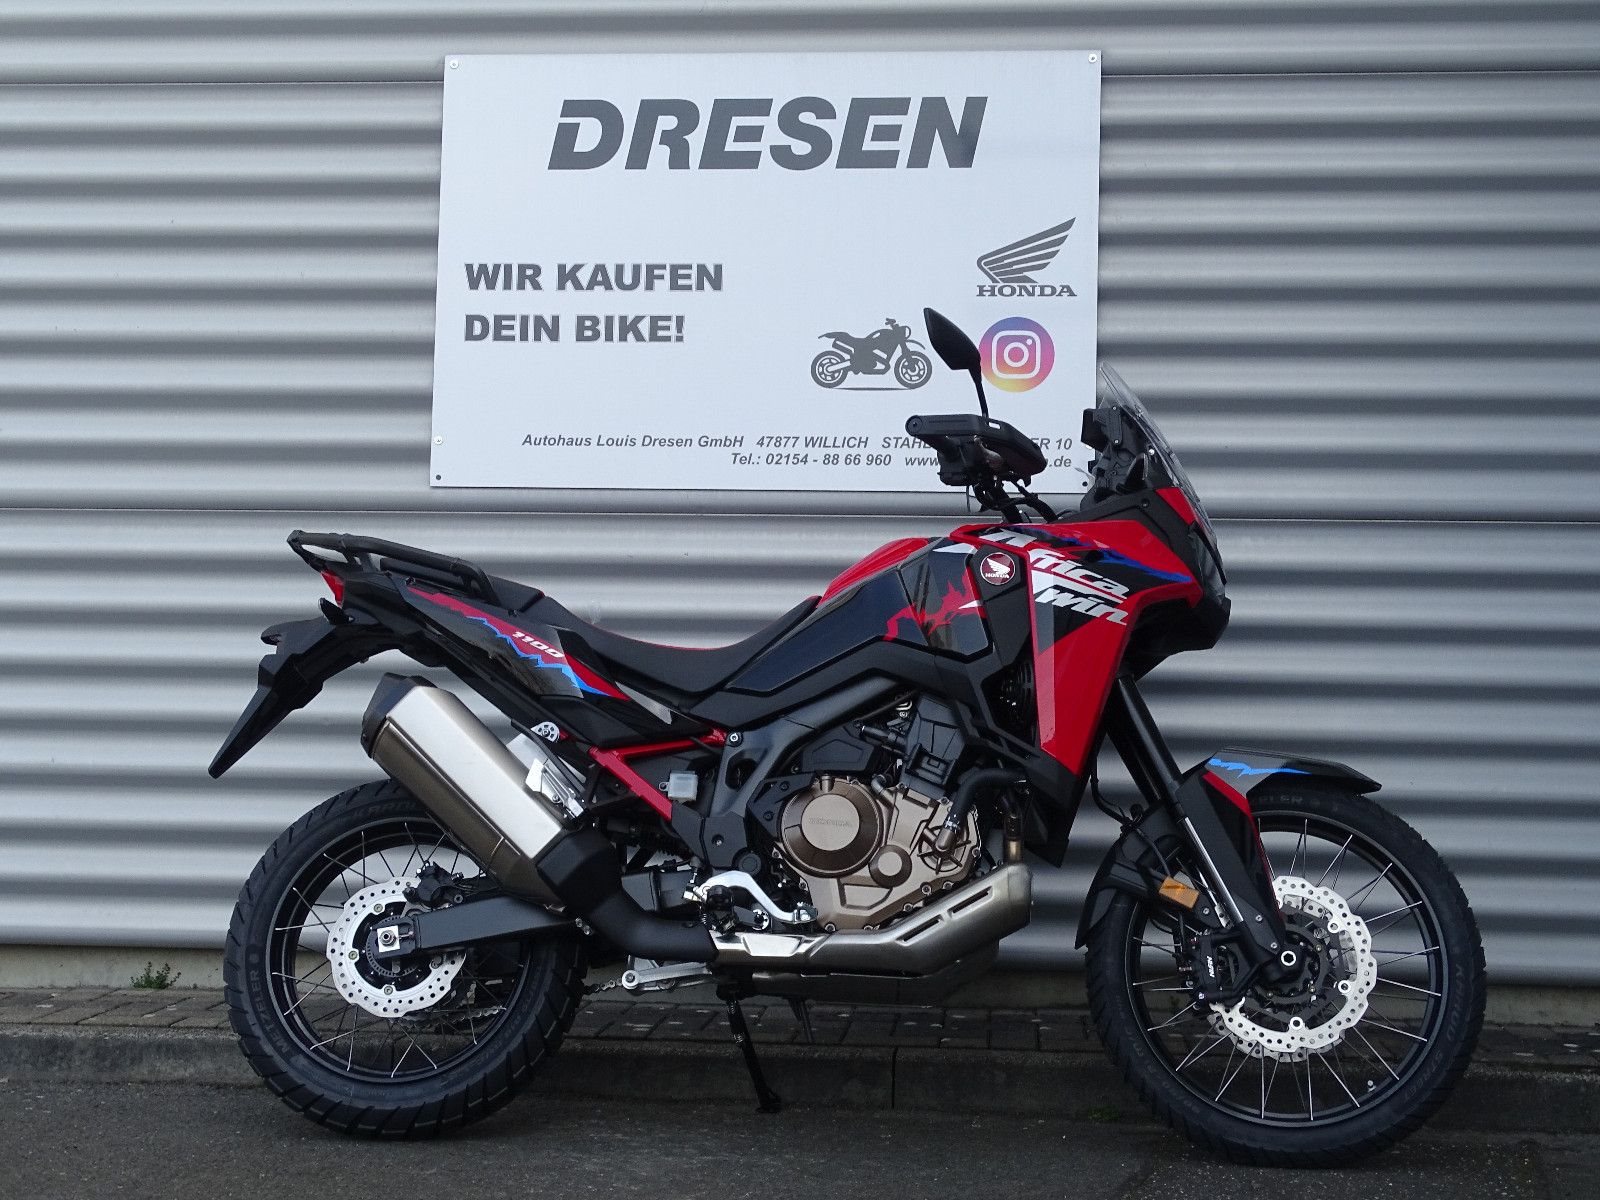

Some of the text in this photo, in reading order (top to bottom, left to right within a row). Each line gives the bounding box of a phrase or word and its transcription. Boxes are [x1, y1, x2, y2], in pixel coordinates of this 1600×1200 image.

[547, 95, 989, 171] DRESEN
[464, 263, 723, 292] WIR KAUFEN
[976, 284, 1078, 297] HONDA
[464, 314, 685, 343] DEIN BIKE!
[521, 434, 592, 447] Autohaus
[596, 434, 637, 447] Louis
[641, 435, 693, 448] Dresen
[697, 435, 745, 448] GmbH
[756, 435, 800, 448] 47877
[804, 436, 869, 449] WILLICH
[1055, 437, 1073, 450] 10
[731, 452, 761, 465] Tel.:
[765, 453, 809, 466] 02154
[822, 453, 840, 466] 88
[844, 453, 862, 466] 66
[865, 453, 892, 467] 960
[512, 631, 566, 658] 1100
